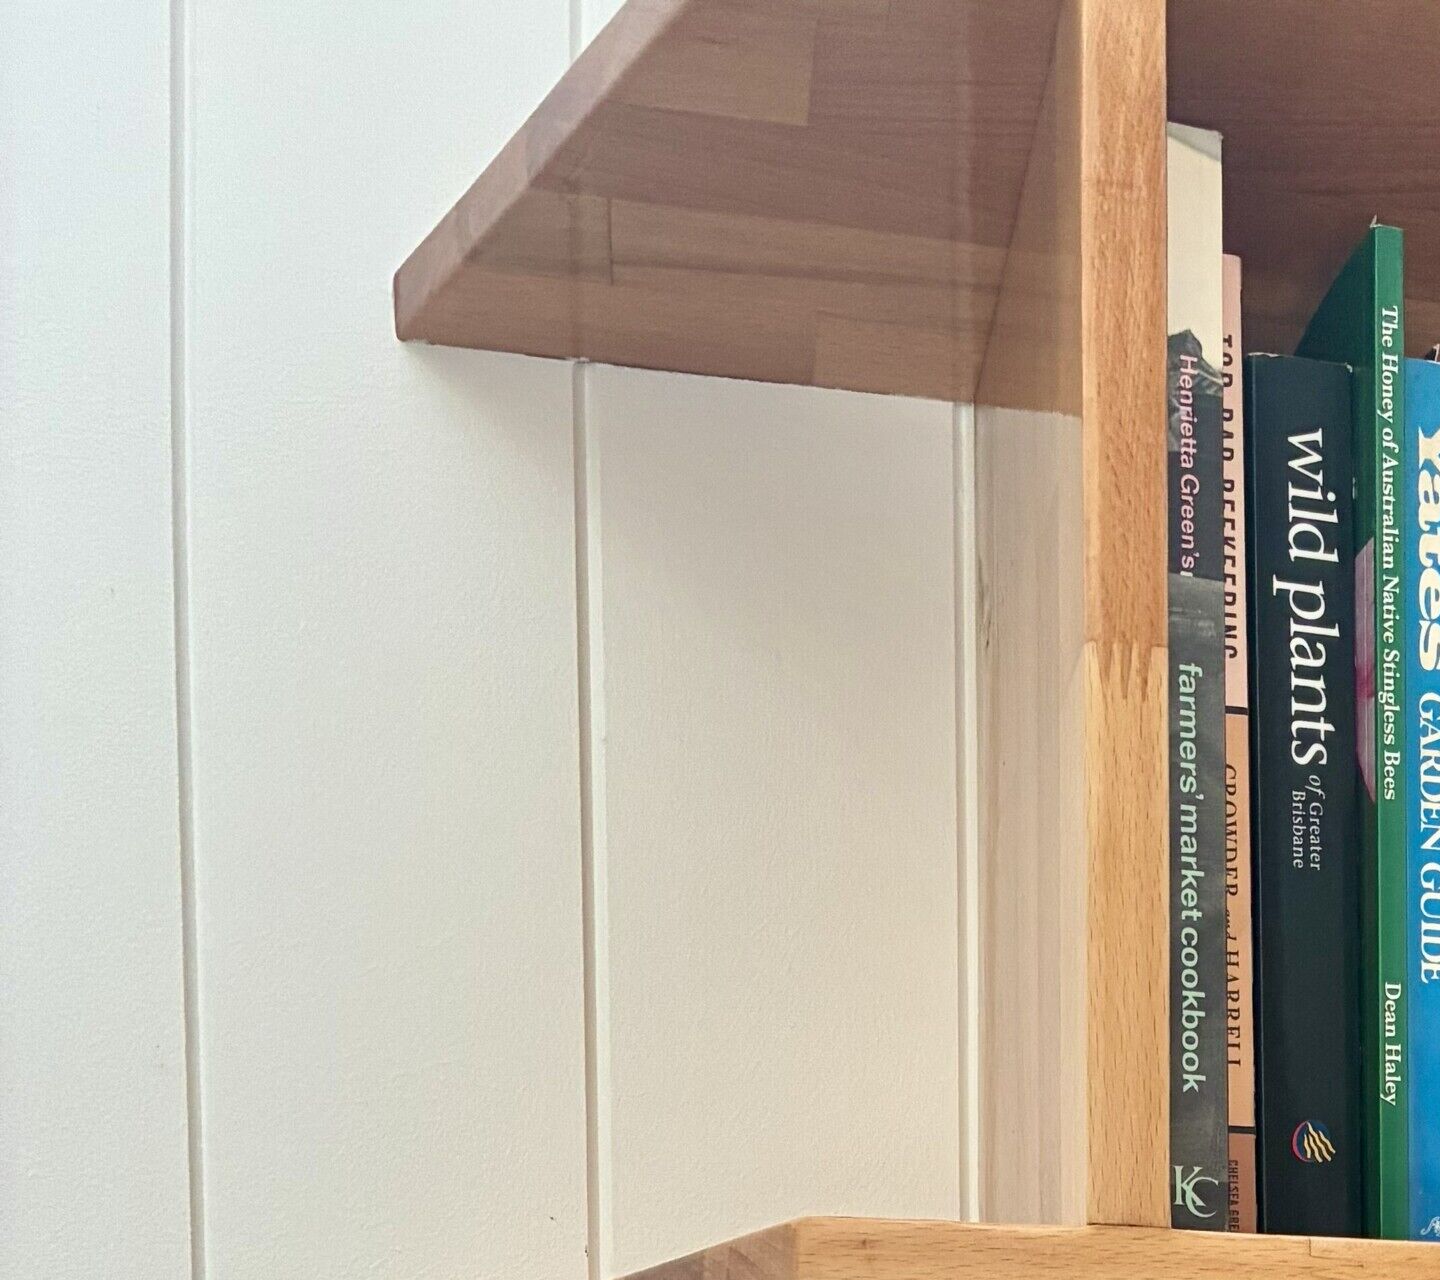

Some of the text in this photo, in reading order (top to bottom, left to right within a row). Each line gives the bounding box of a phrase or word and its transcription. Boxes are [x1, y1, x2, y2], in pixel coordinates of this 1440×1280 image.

[1178, 354, 1200, 569] Henrietta Green's
[1377, 306, 1400, 800] The Honey of Australian Native Stingless Bees
[1272, 428, 1340, 766] wild plants
[1179, 663, 1207, 1093] farmers' market cookbook
[1292, 790, 1306, 869] Brisbane
[1304, 775, 1325, 872] of Greater
[1380, 982, 1400, 1106] Dean Haley
